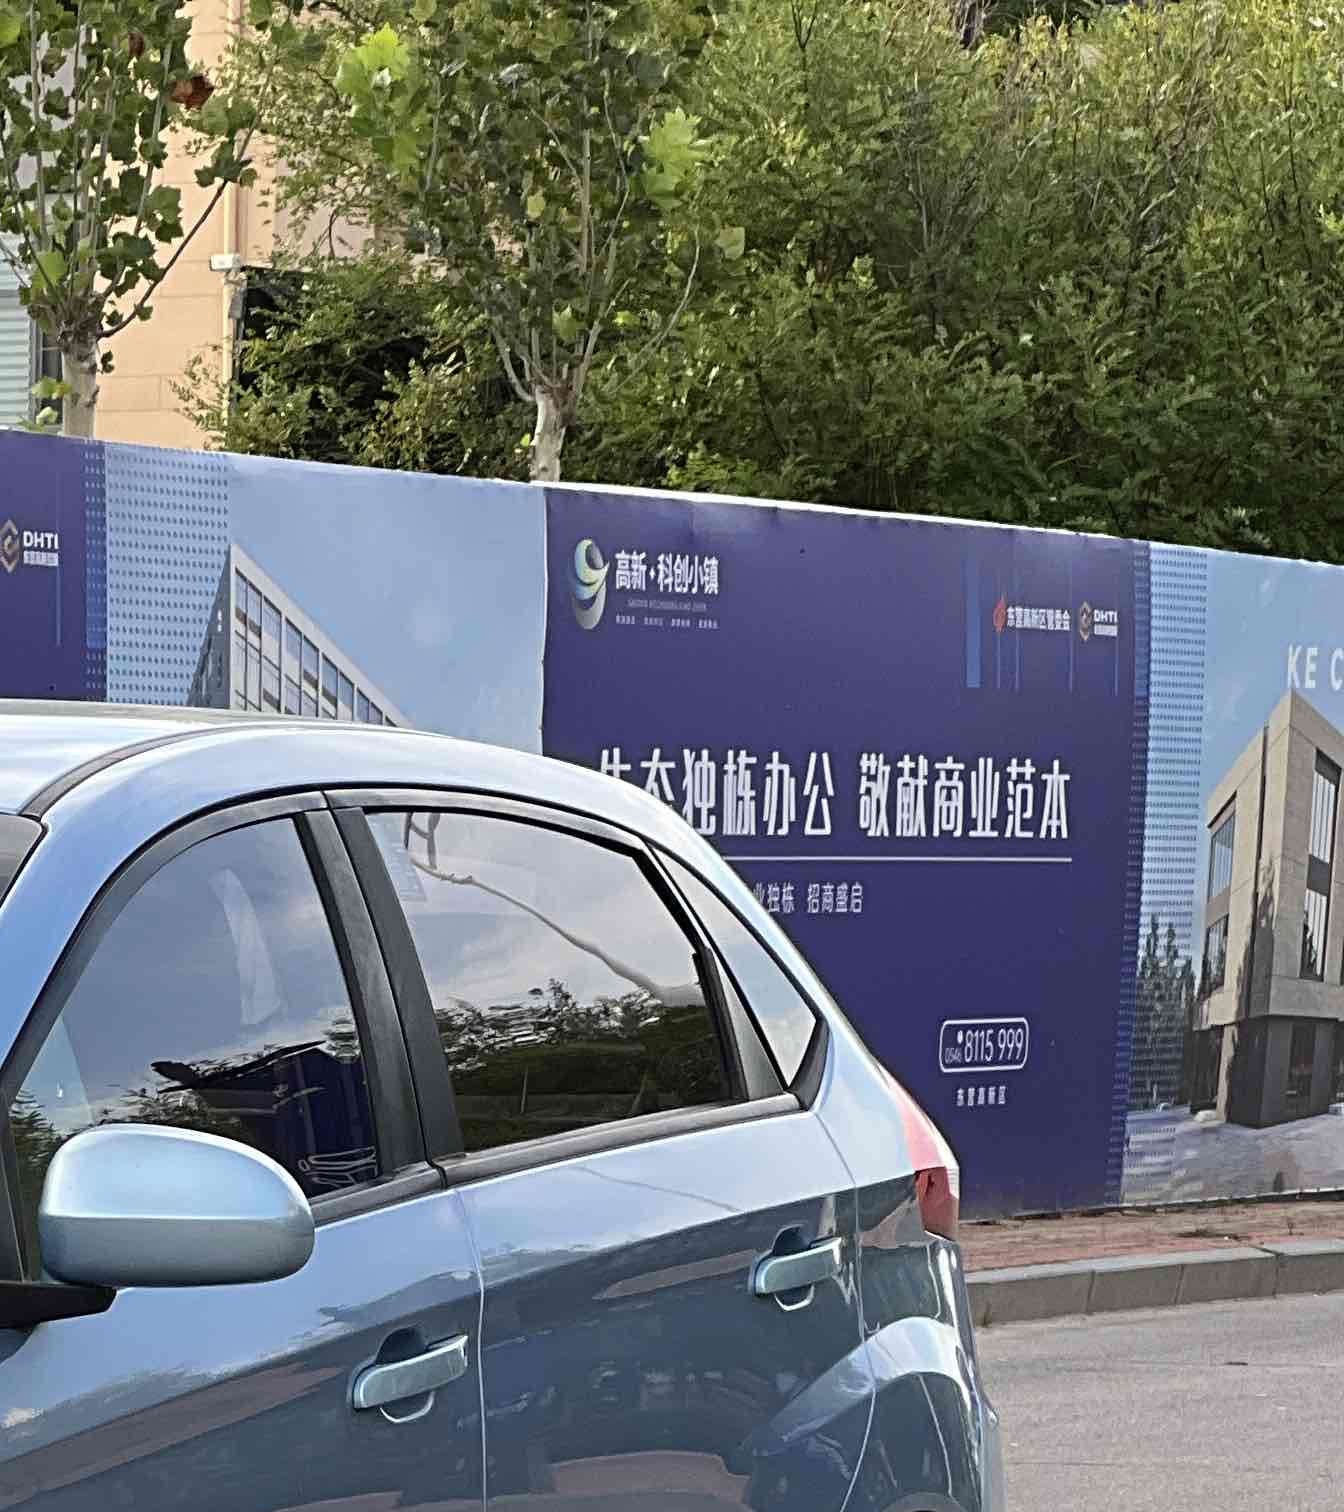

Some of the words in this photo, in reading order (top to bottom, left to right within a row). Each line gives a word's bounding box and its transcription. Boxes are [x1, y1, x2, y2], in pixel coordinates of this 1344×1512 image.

[23, 530, 59, 550] DHTI
[859, 752, 1071, 839] 敬献商业范本
[807, 881, 864, 913] 招商盛启
[964, 1029, 993, 1063] 8115
[998, 1028, 1024, 1061] 999
